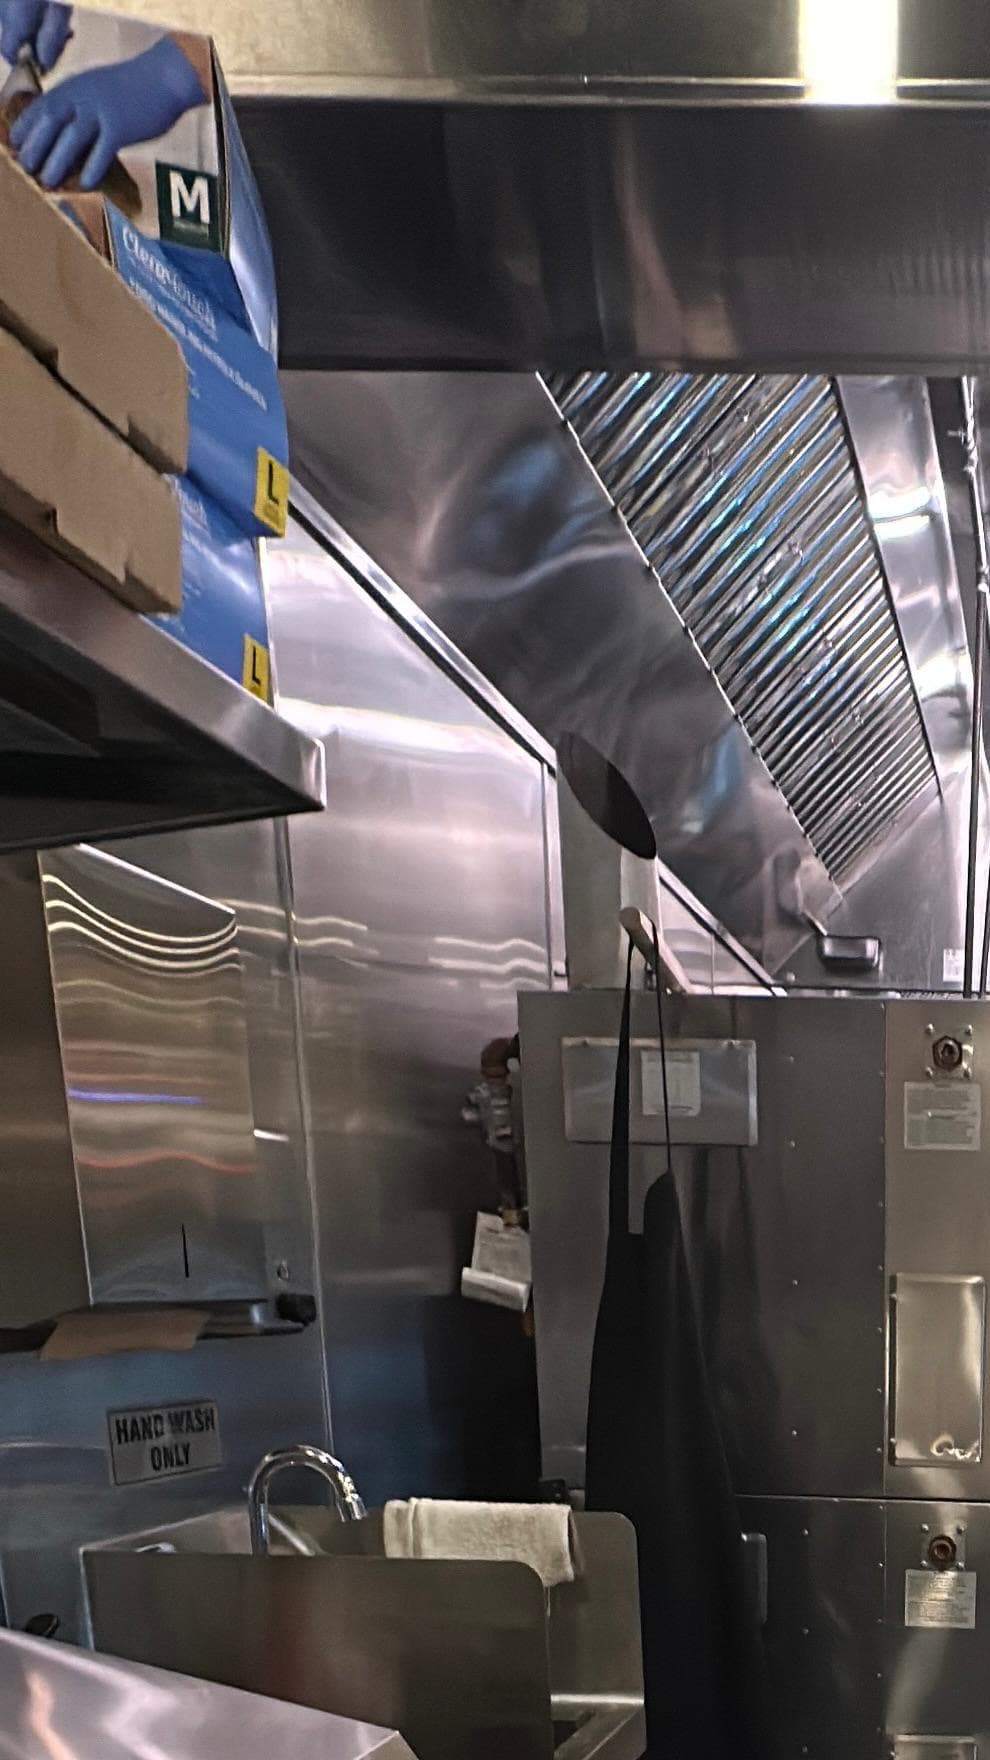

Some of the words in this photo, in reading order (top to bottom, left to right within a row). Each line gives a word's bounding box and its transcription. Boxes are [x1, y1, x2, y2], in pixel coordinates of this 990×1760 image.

[169, 169, 211, 225] M
[268, 462, 281, 505] L
[115, 1413, 165, 1445] HAND
[167, 1407, 216, 1434] WASH
[150, 1442, 191, 1472] ONLY
